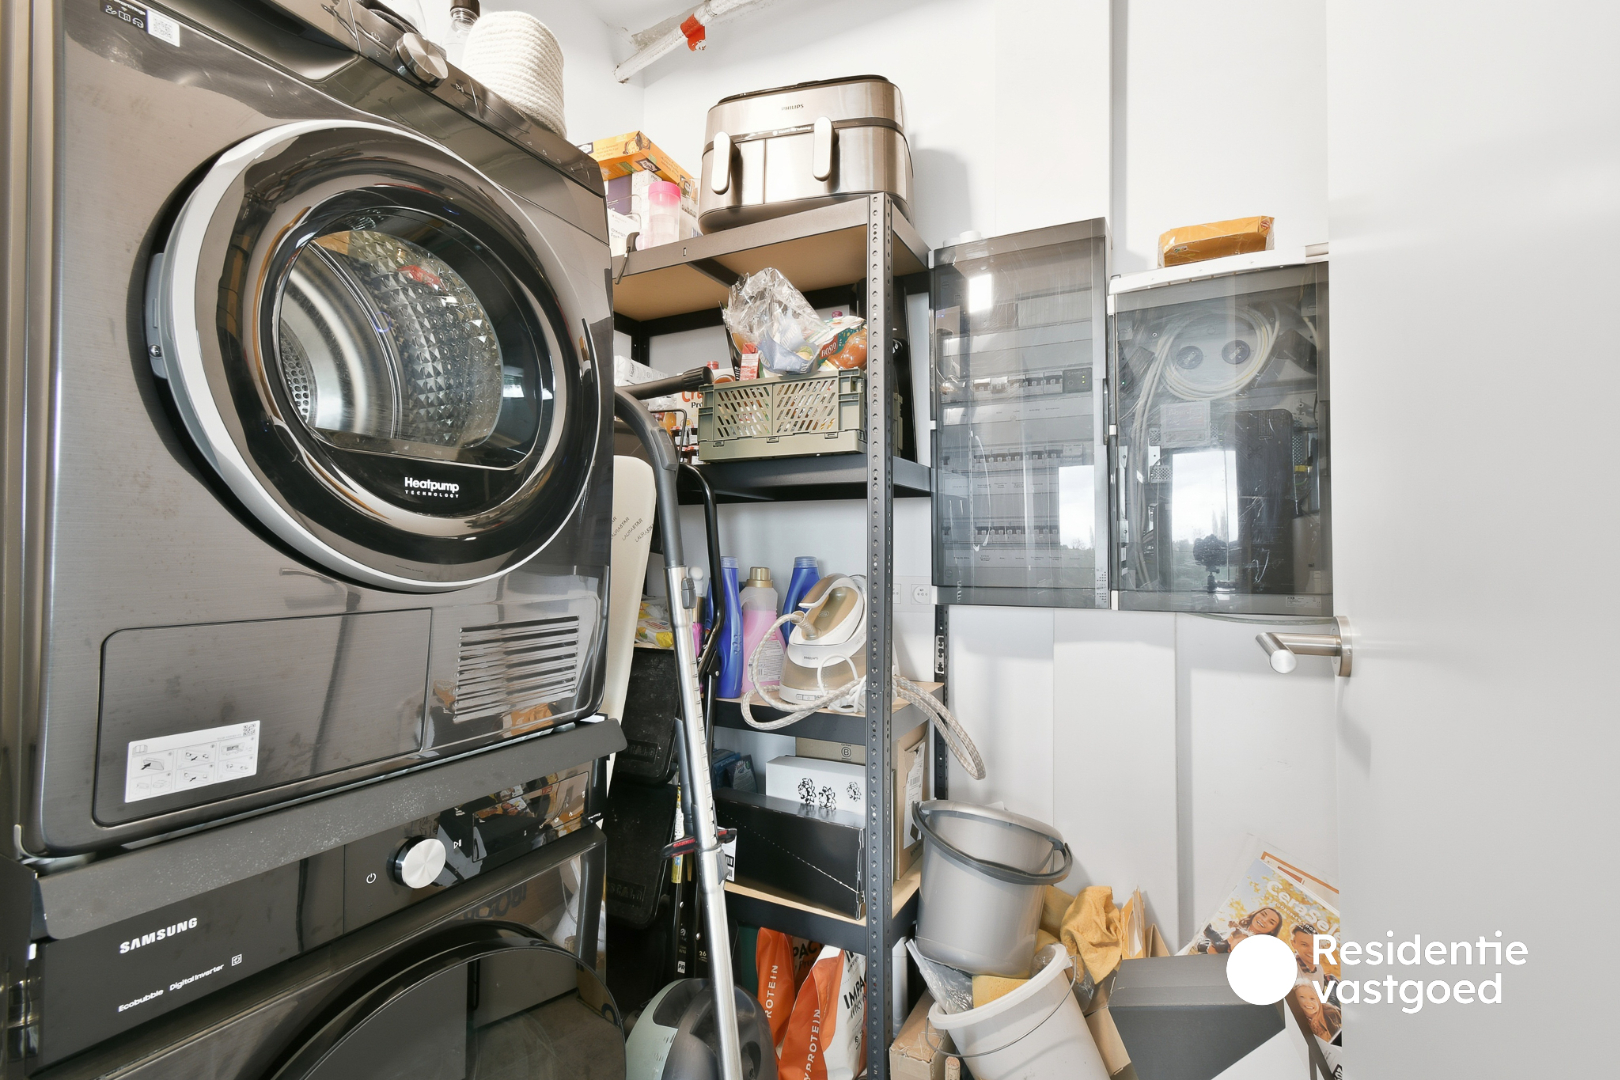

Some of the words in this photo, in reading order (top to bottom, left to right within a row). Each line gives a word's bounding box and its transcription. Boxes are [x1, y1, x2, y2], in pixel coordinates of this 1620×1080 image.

[404, 476, 460, 494] Heatpump
[404, 490, 459, 498] TECHNOLOGY
[119, 917, 198, 954] SAMSUNG
[117, 988, 164, 1012] Ecobubble
